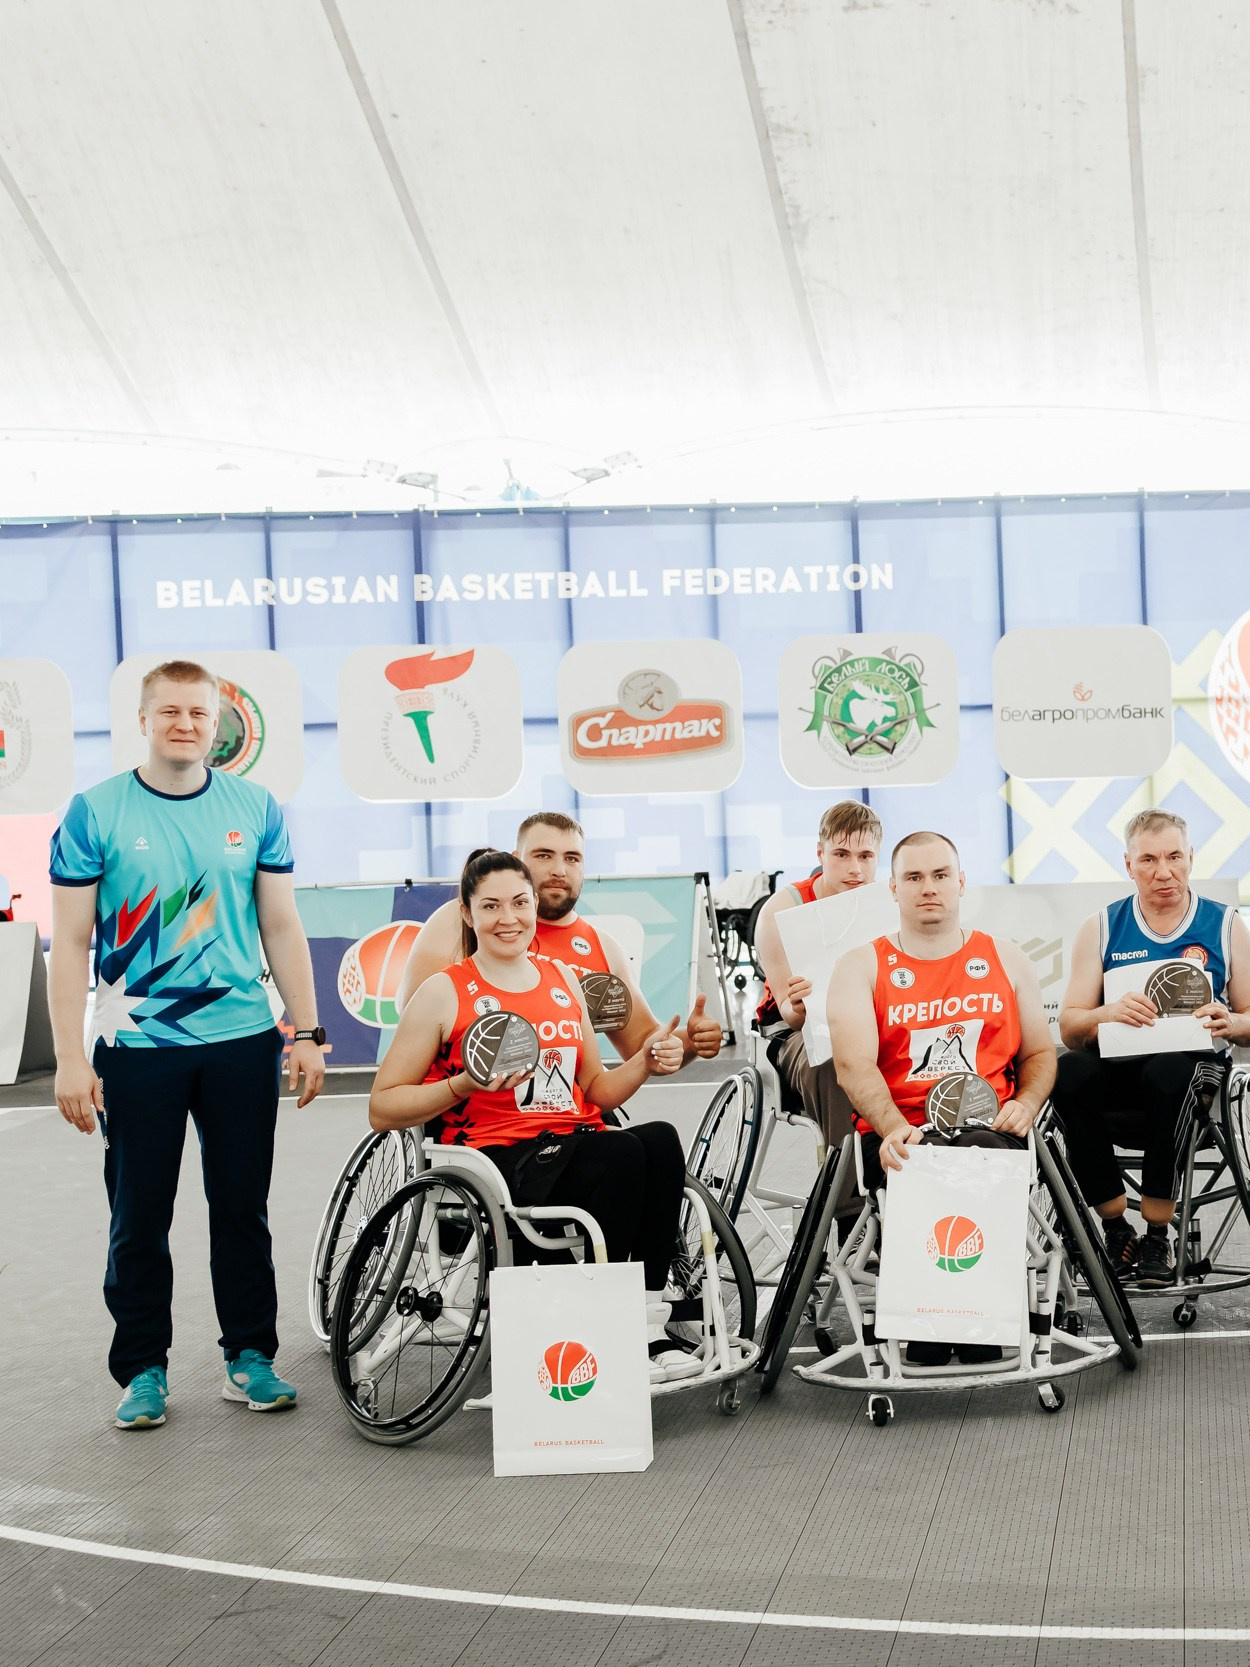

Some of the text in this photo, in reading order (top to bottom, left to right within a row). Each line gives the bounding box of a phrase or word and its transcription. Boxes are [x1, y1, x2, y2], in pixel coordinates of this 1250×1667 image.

[155, 563, 894, 609] BELARUSIAN BASKETBALL FEDERATION
[875, 661, 911, 689] ЛОСЬ
[1000, 704, 1165, 724] белагропромбанк
[576, 712, 722, 750] Спартак
[1111, 949, 1149, 961] macron
[888, 993, 1004, 1026] КРЕПОСТЬ
[959, 1230, 982, 1257] BBF
[571, 1354, 596, 1385] BBF
